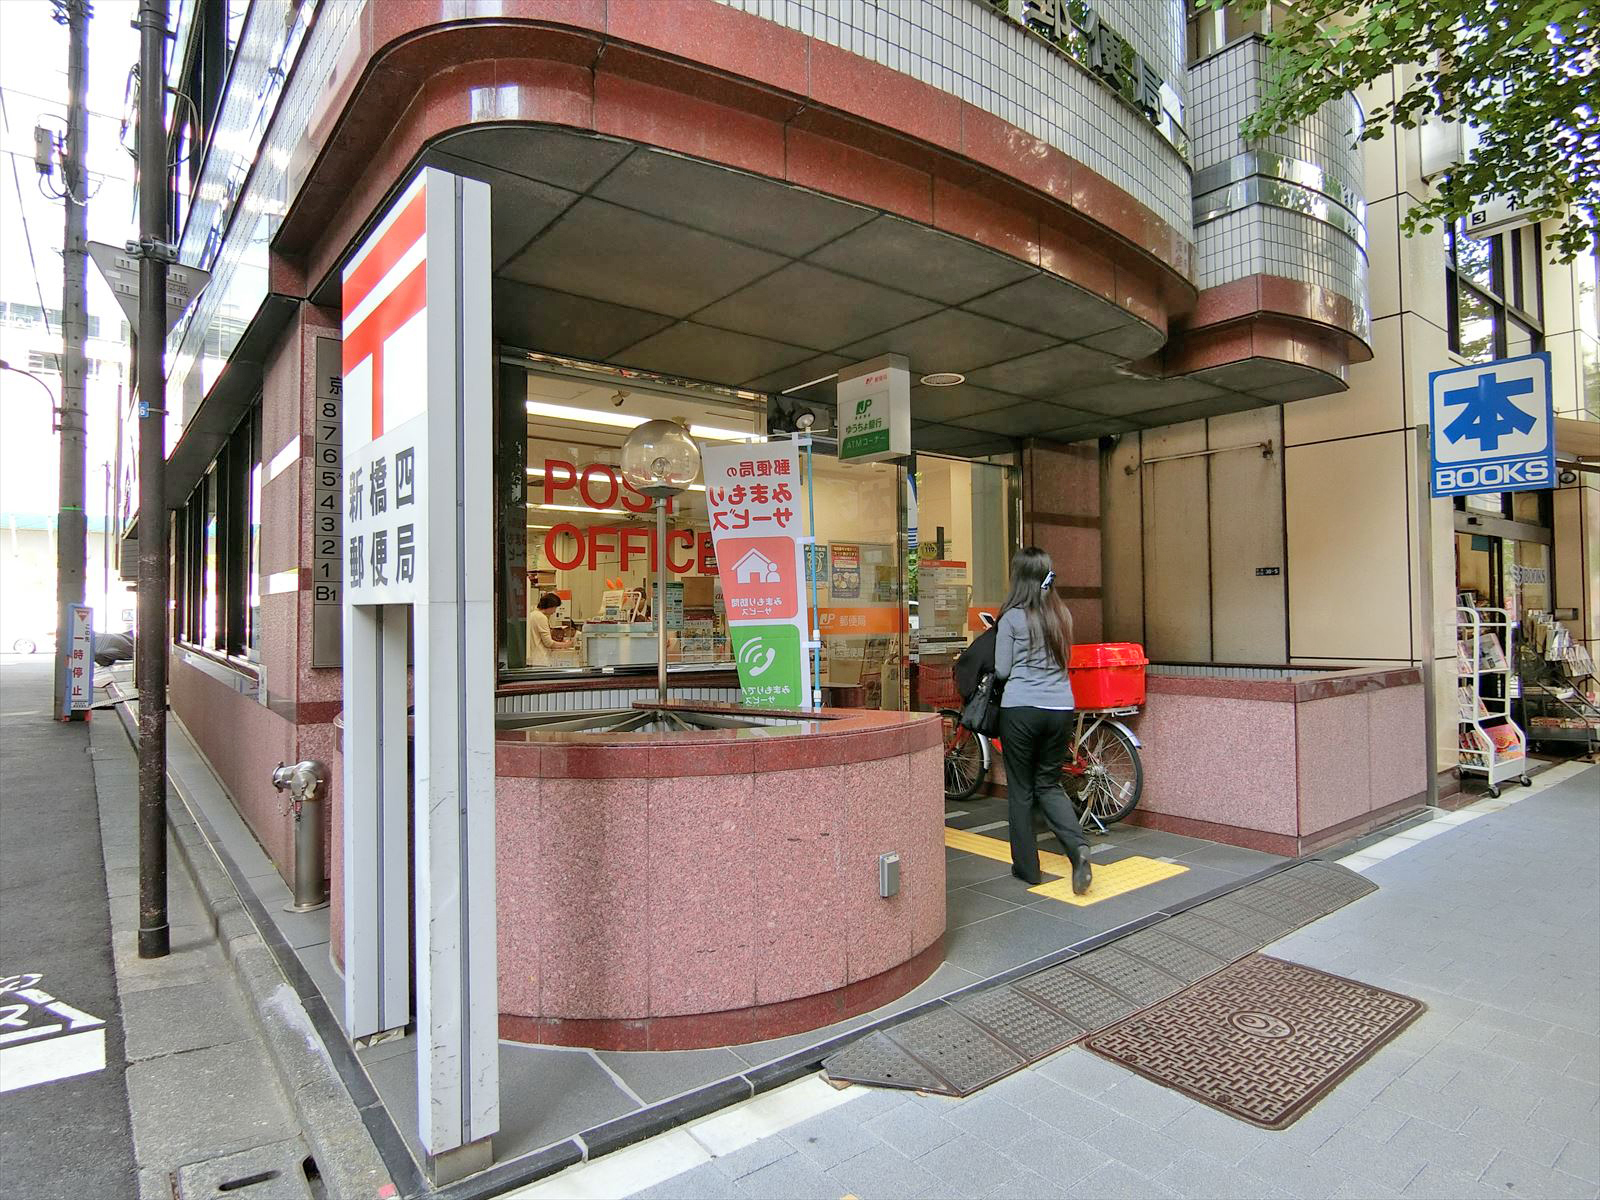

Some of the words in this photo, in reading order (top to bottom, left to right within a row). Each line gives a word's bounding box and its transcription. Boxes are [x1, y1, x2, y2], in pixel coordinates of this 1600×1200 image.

[322, 403, 336, 417] 8
[1443, 372, 1537, 451] 本
[322, 425, 336, 440] 7
[846, 418, 882, 434] ゆうちょ銀行
[323, 448, 337, 463] 6
[322, 471, 336, 486] 5
[1436, 460, 1549, 490] BOOKS
[349, 446, 415, 523] 新橋四
[320, 495, 335, 509] 4
[321, 517, 335, 531] 3
[321, 540, 335, 554] 2
[545, 523, 720, 576] OFFICE
[350, 523, 416, 588] 郵便局
[321, 563, 329, 577] 1
[316, 586, 336, 601] B1
[71, 636, 85, 696] 一時停止
